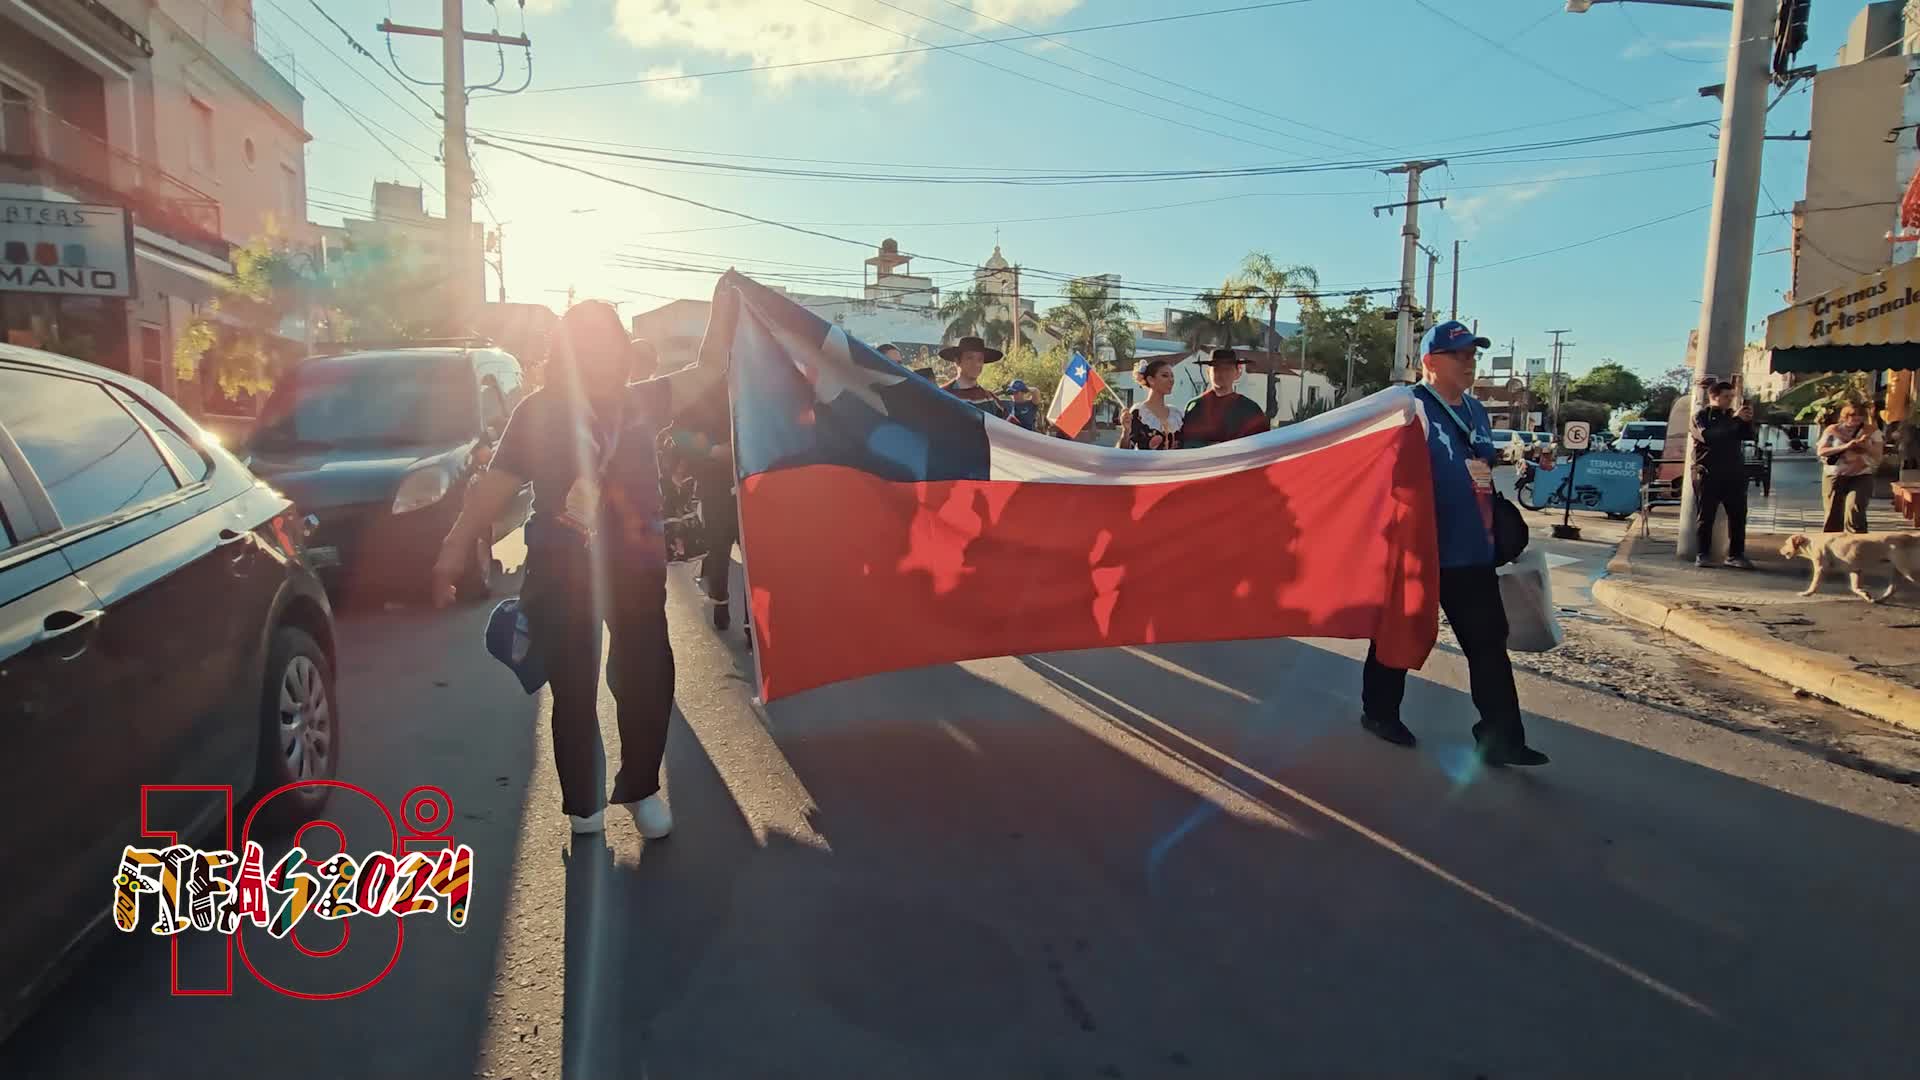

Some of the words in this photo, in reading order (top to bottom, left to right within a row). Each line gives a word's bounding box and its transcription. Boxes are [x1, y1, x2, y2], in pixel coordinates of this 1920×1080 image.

[0, 267, 117, 290] MANO
[1813, 281, 1888, 316] Cremas
[1590, 459, 1623, 469] TERMAS
[1624, 461, 1637, 470] DE
